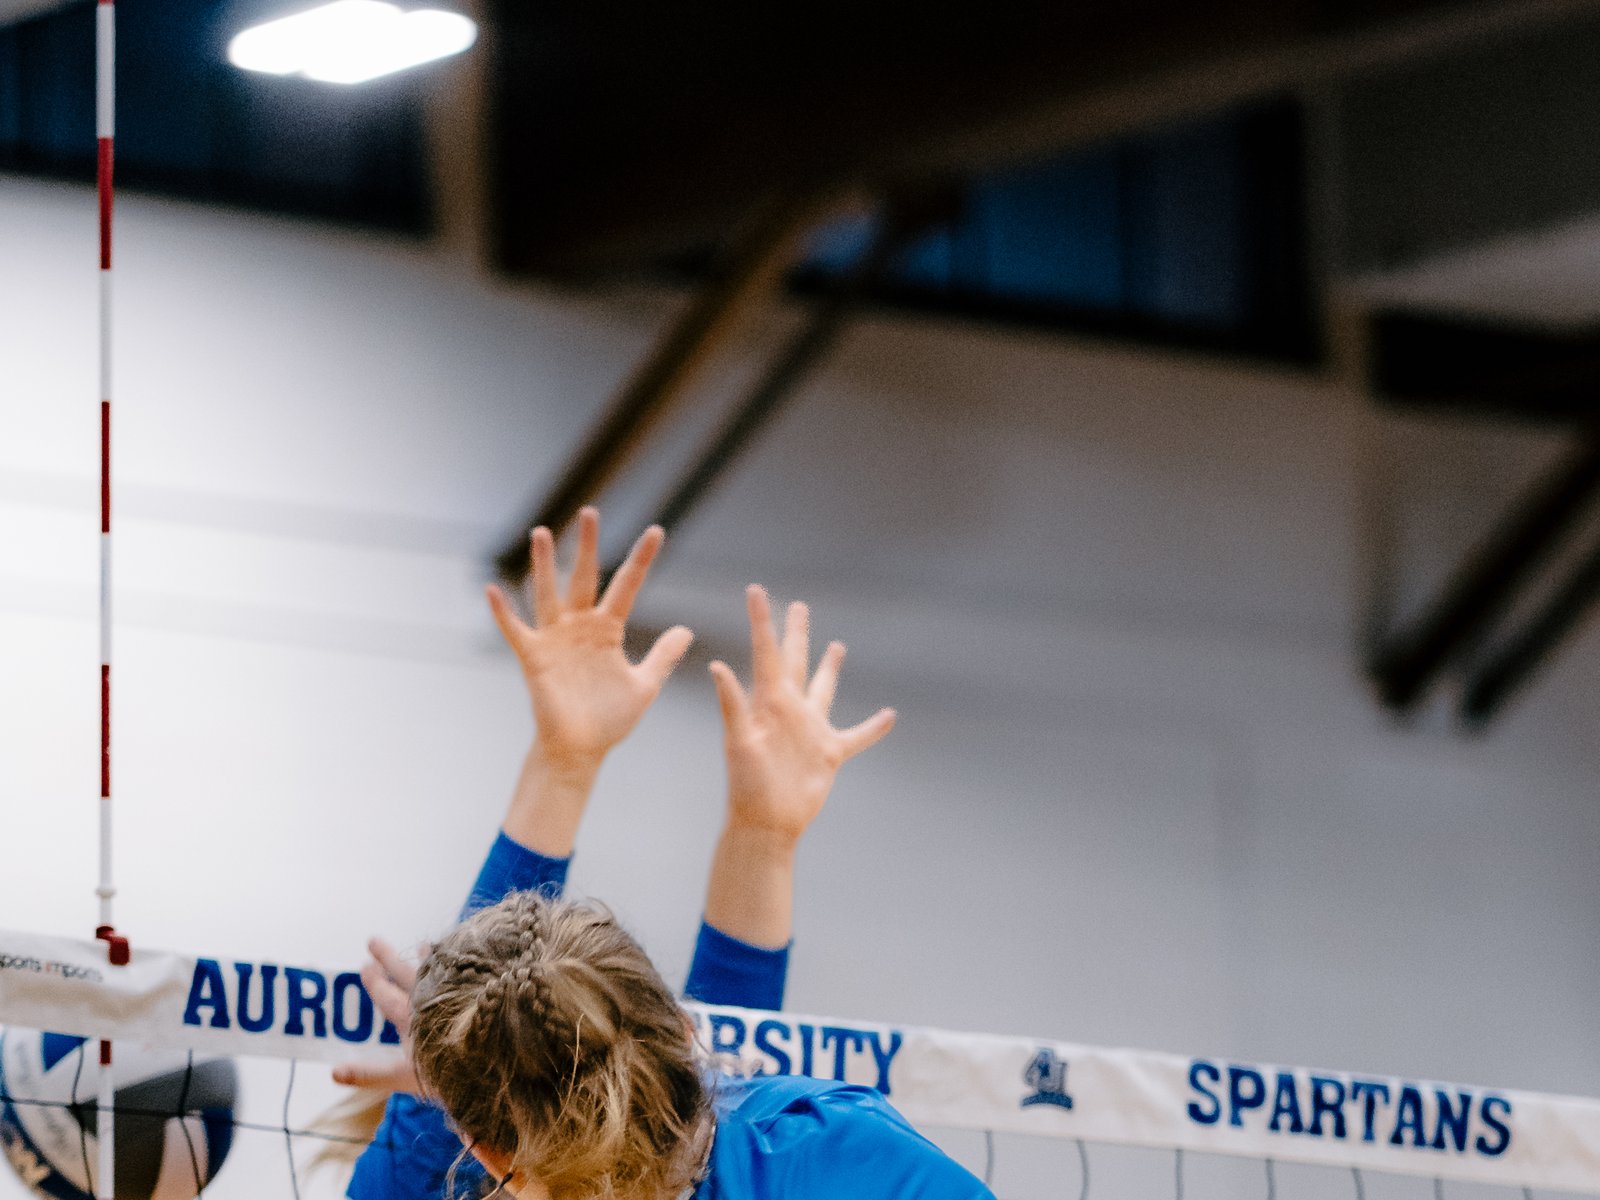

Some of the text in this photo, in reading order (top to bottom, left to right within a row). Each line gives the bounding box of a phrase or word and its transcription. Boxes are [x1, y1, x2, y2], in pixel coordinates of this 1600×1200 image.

[183, 957, 1512, 1157] AURO RSITY SPARTANS
